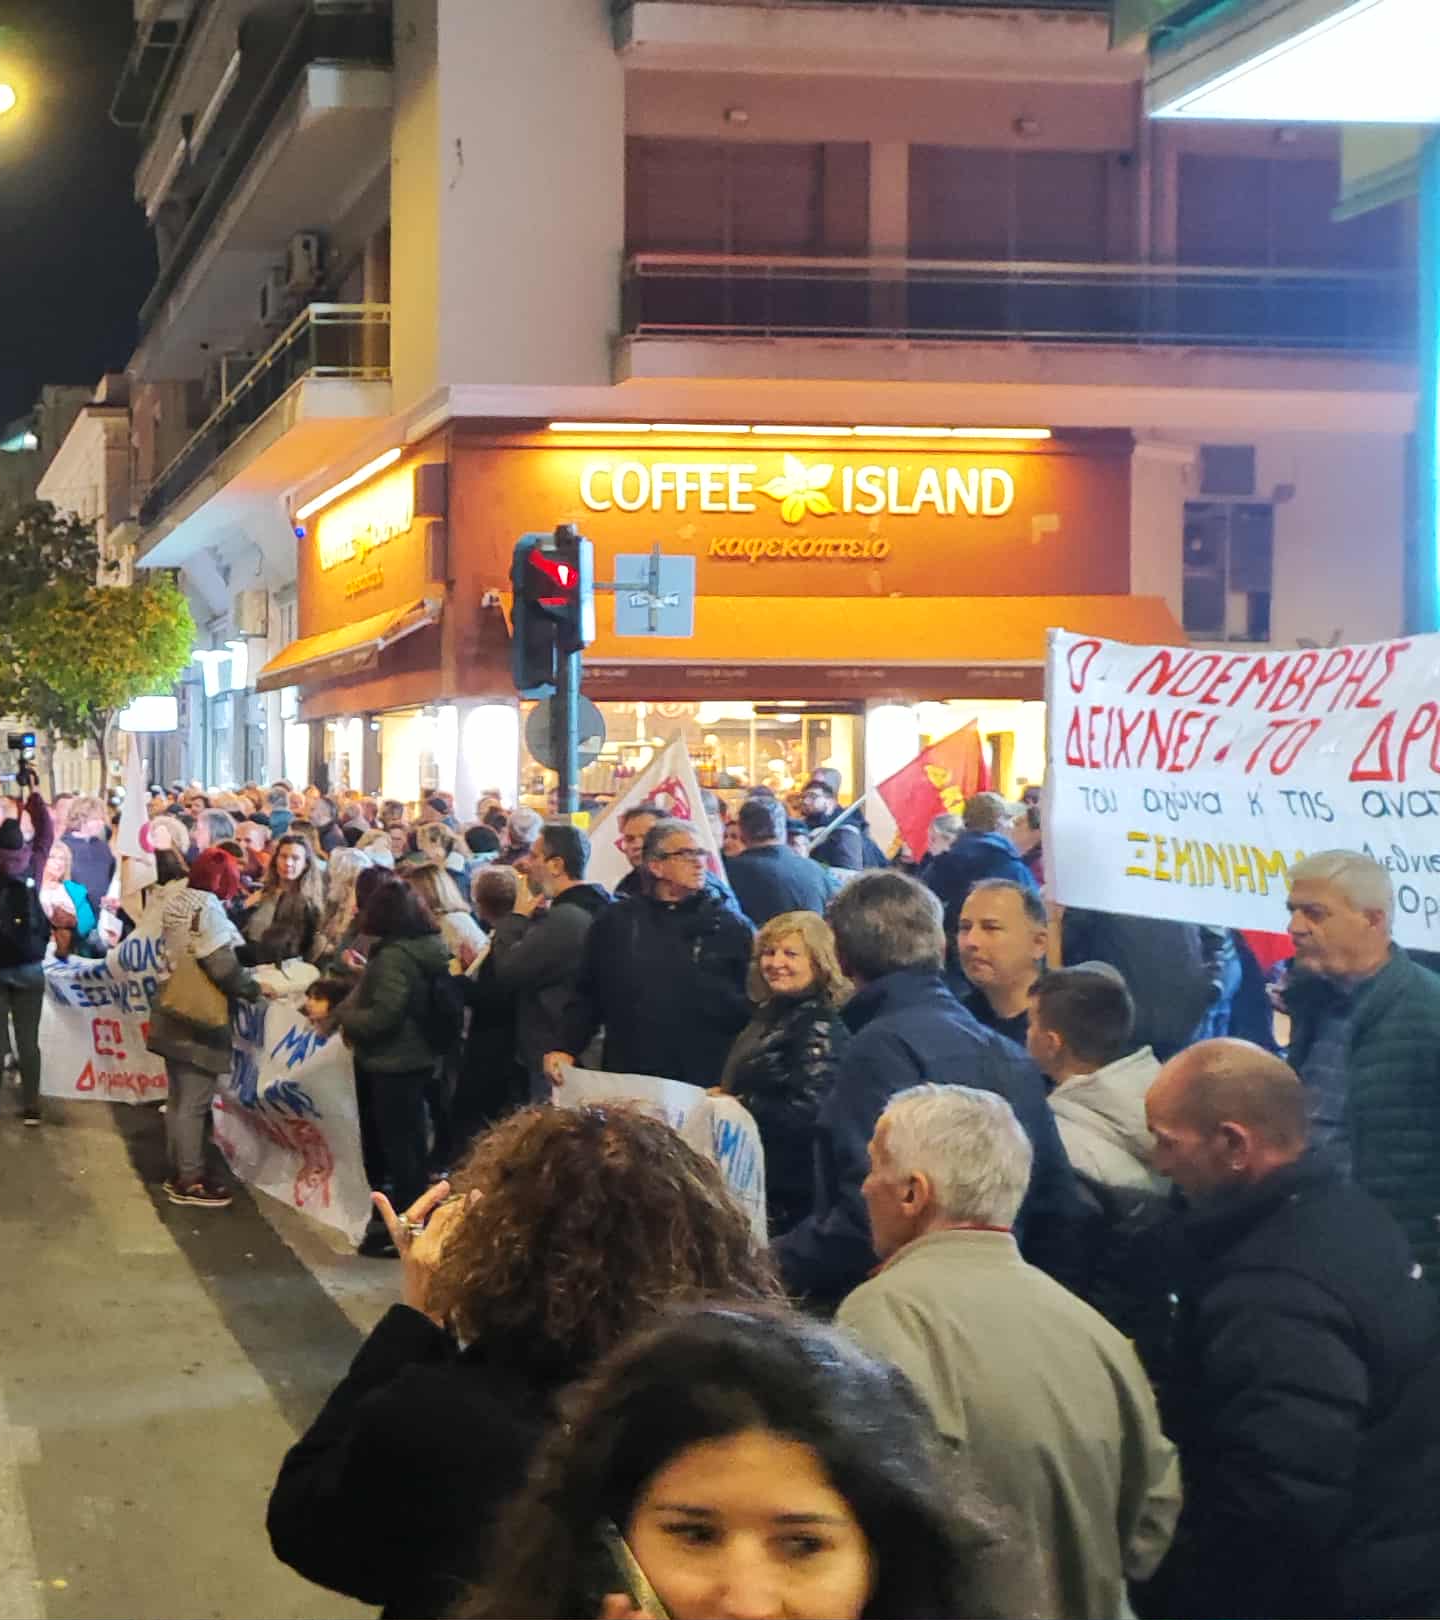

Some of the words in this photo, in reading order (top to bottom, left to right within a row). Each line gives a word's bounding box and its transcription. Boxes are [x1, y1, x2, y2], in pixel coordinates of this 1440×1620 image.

[579, 462, 758, 512] COFFEE
[841, 465, 1015, 516] ISLAND
[1126, 642, 1412, 712] ΝΟΕΜΒΡΗΣ
[1244, 717, 1322, 776] ΤΟ
[1349, 701, 1440, 783] ΔΡ
[1125, 831, 1304, 896] ΞΕΚΙΝΗΜ
